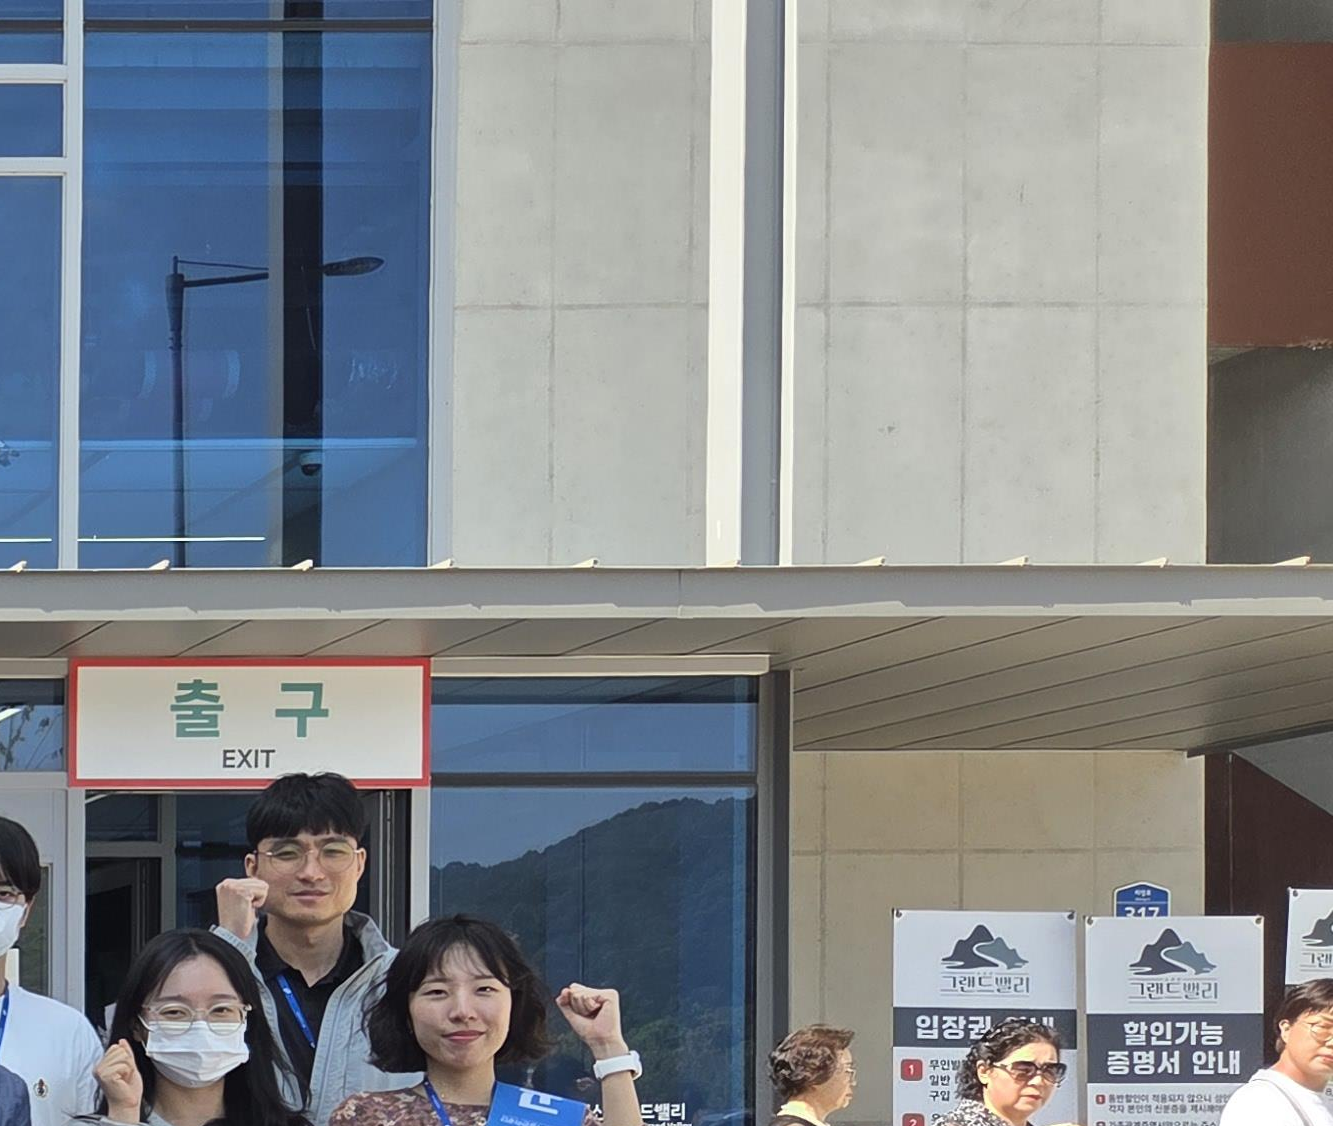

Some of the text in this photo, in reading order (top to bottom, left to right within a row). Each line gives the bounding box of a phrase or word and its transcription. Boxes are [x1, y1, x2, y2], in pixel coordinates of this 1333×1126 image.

[222, 749, 275, 768] EXIT
[941, 975, 1030, 994] 그랜드밸리
[1129, 982, 1218, 1000] 그랜드밸리
[1124, 1021, 1223, 1046] 할인가능
[1107, 1050, 1240, 1075] 증명서 안내
[929, 1075, 950, 1086] 일반
[929, 1090, 950, 1102] 구입
[641, 1103, 685, 1120] 드밸리
